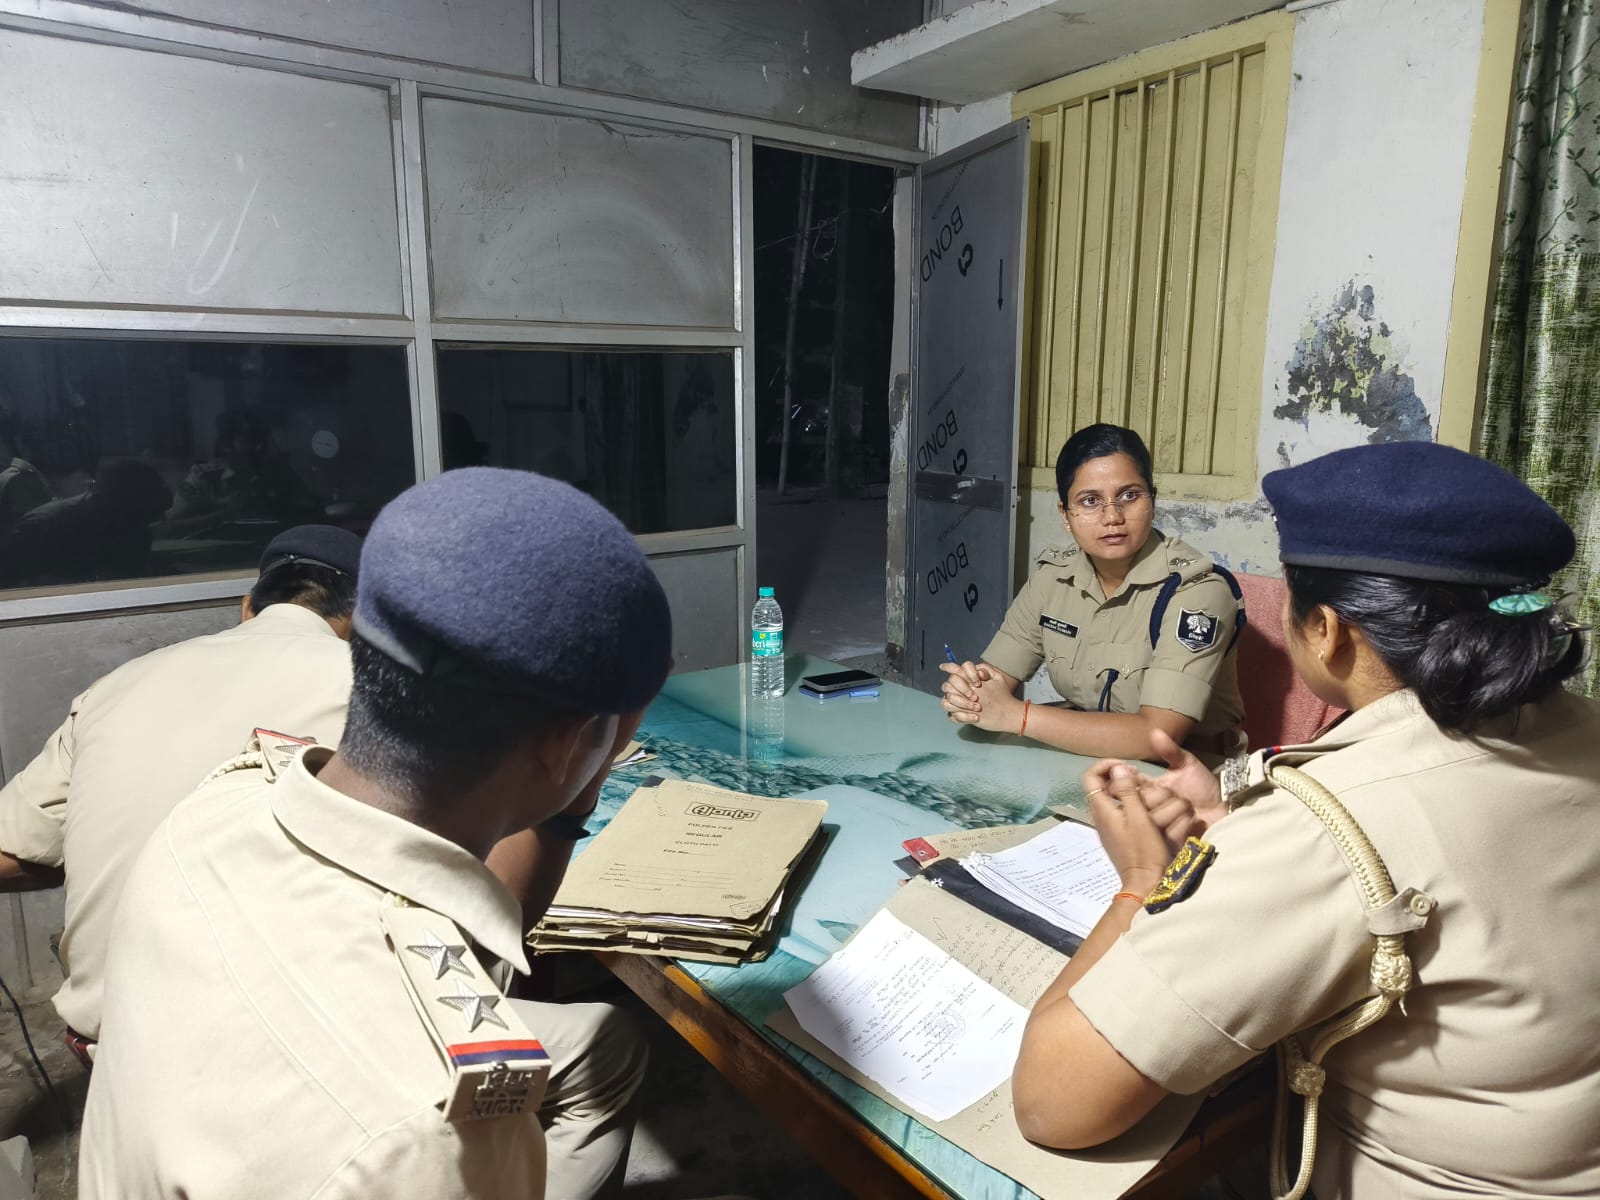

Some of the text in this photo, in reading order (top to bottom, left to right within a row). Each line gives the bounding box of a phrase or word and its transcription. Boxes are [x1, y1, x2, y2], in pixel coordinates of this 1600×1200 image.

[920, 205, 964, 282] BOND
[917, 409, 958, 471] BOND
[927, 542, 969, 595] BOND
